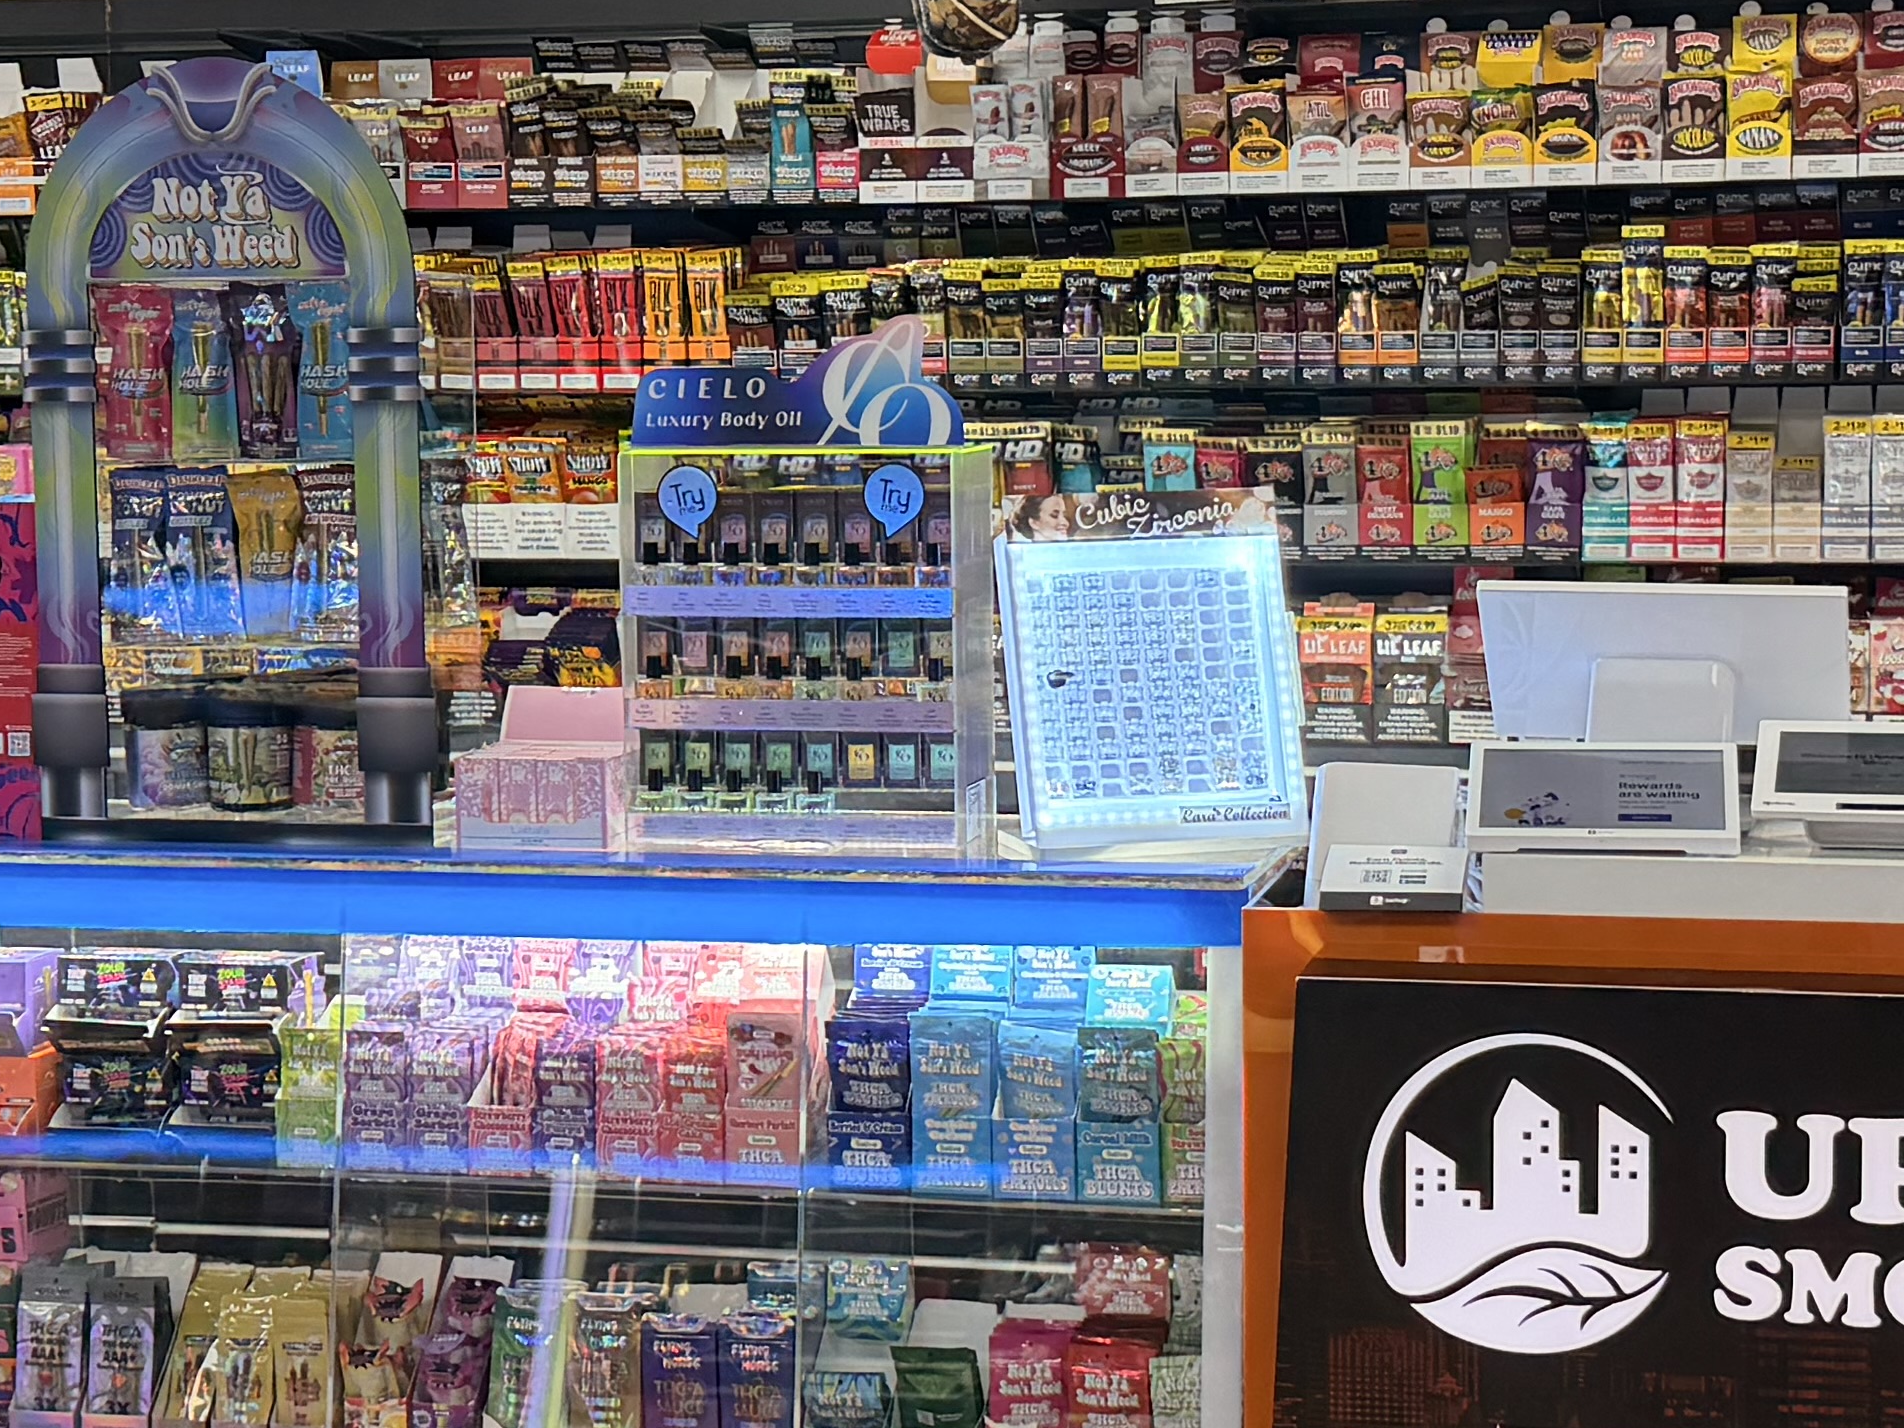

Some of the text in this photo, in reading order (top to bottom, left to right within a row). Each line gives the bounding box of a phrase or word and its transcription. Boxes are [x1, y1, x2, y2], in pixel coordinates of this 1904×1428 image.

[1361, 88, 1390, 110] CHI
[865, 104, 900, 117] TRUE
[861, 118, 911, 133] WRAPS
[152, 177, 220, 222] Not
[131, 222, 299, 268] Son's Weed
[112, 367, 164, 382] HASH
[181, 364, 229, 379] HASH
[300, 363, 347, 378] HASH
[648, 376, 767, 401] CIELO
[645, 410, 802, 432] Luxury Body Oil
[667, 482, 705, 517] Try
[878, 476, 912, 515] Try
[1075, 498, 1236, 541] Cubic Zirconia
[1618, 781, 1683, 791] Rewards
[1618, 789, 1700, 800] are waiting
[1083, 1132, 1151, 1146] Cereal Milk
[1096, 1164, 1140, 1182] THCA
[1086, 1179, 1153, 1198] BLUNTS
